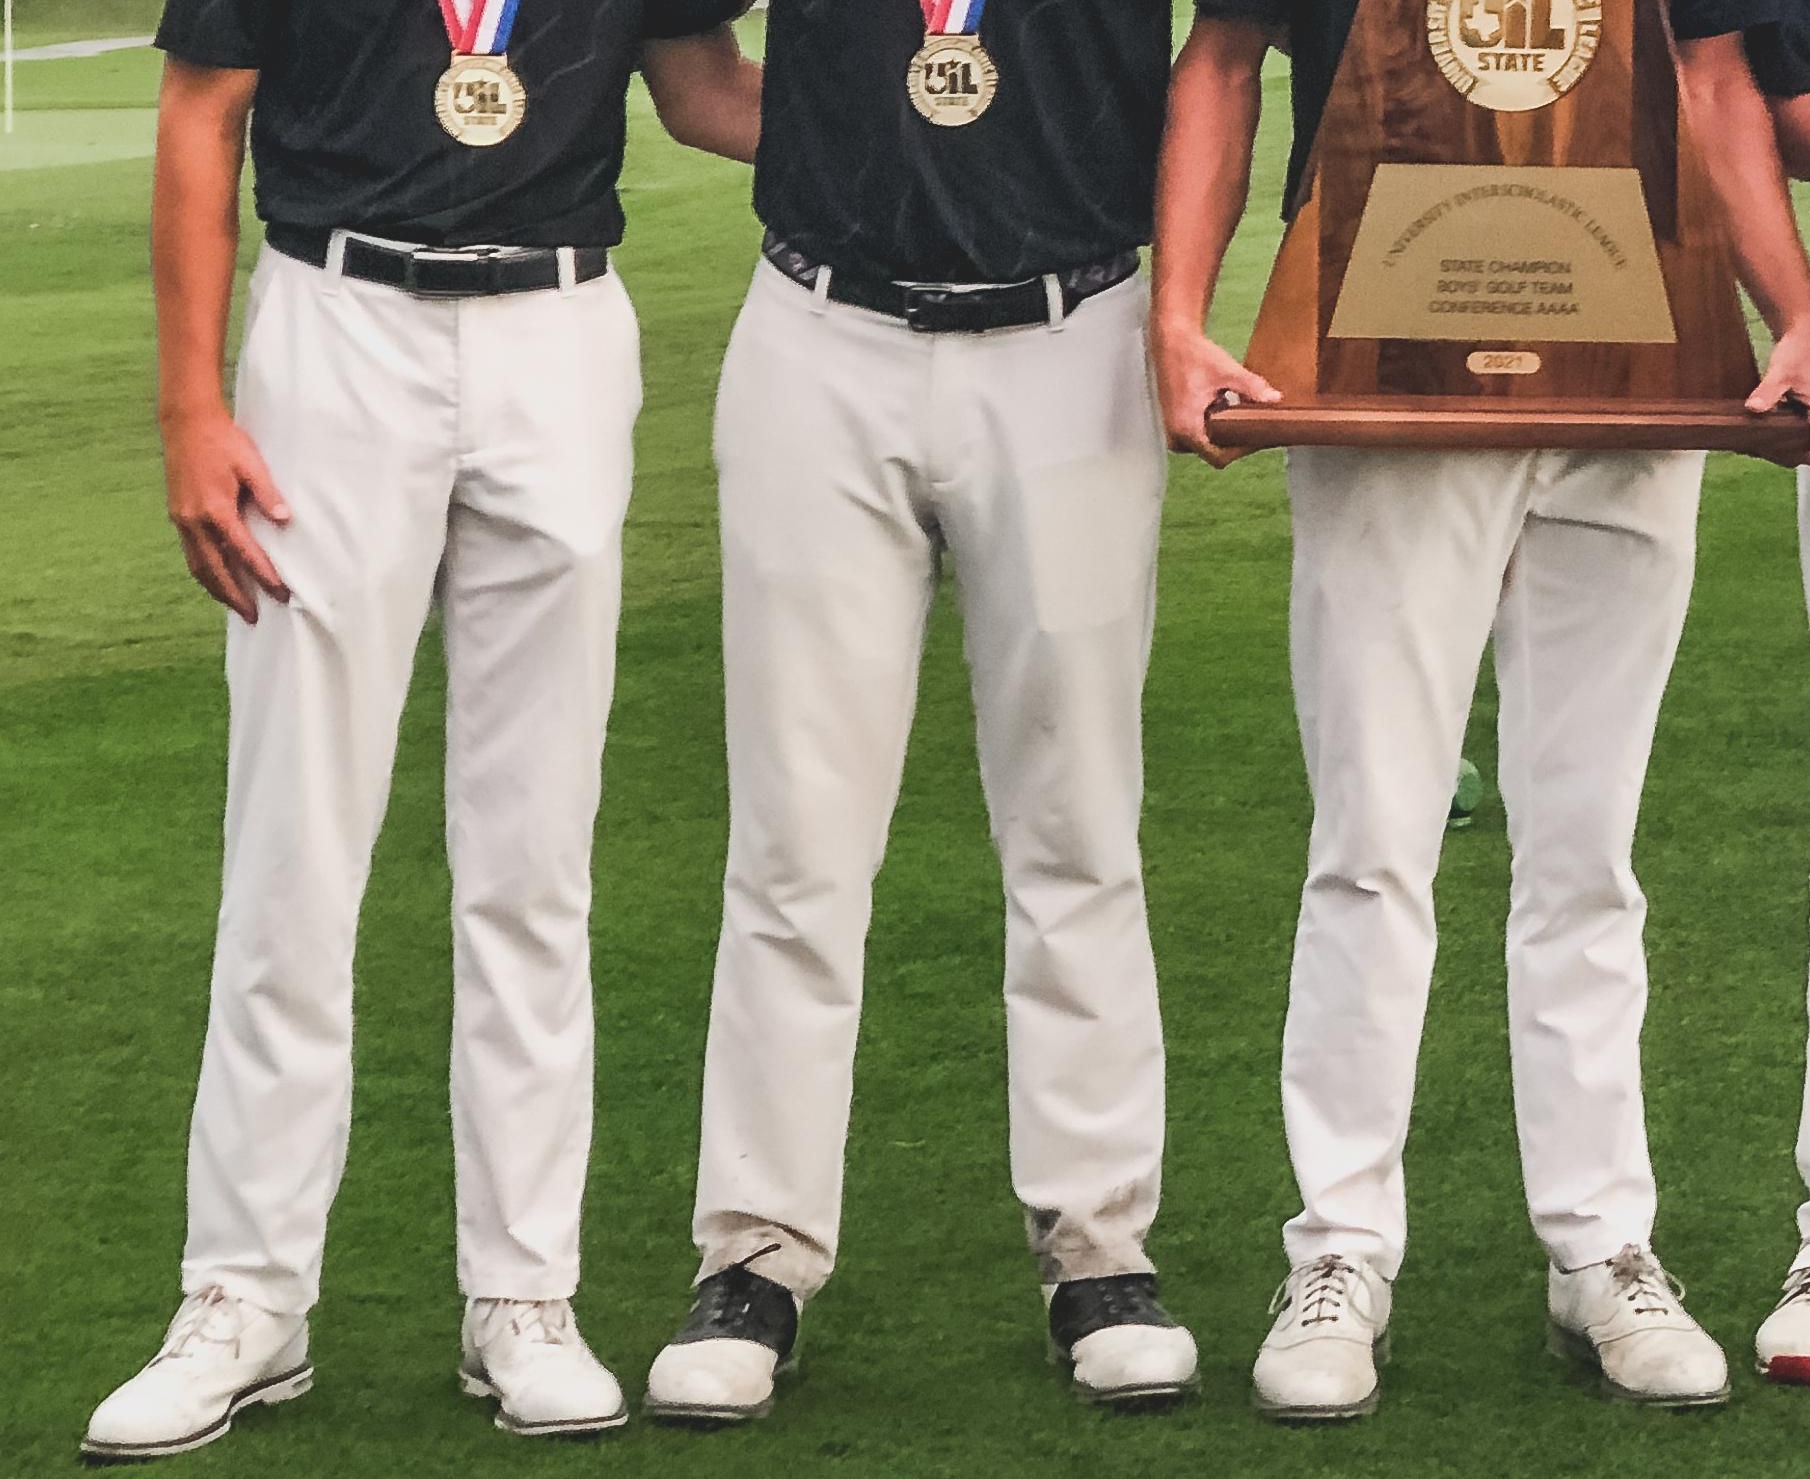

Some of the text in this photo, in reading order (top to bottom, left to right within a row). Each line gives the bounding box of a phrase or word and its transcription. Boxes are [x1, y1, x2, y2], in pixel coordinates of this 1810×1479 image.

[1478, 53, 1545, 71] STATE
[1440, 259, 1572, 274] STATE CHAMPION
[1486, 281, 1527, 294] GOLF
[1531, 281, 1573, 294] TEAM
[1428, 301, 1580, 315] CONFERENCE AAAA
[1483, 354, 1523, 368] 2021
